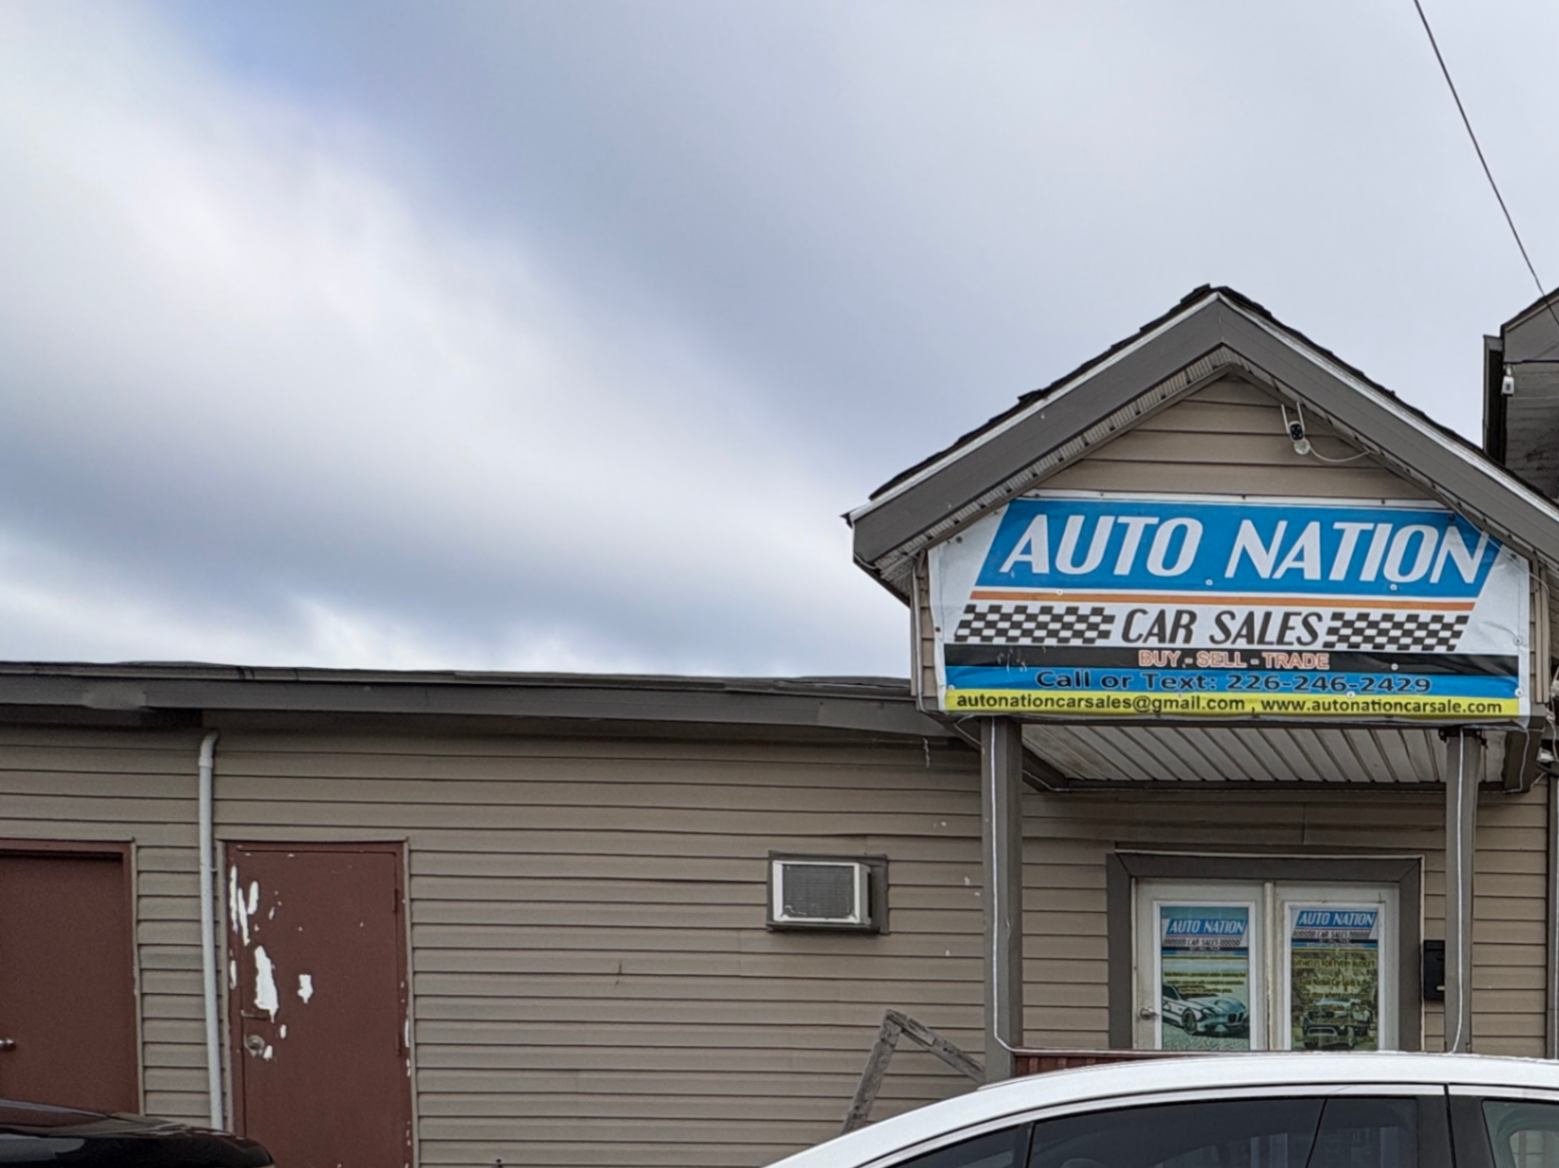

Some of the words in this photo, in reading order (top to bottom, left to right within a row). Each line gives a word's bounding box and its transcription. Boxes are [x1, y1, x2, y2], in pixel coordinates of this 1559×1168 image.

[999, 514, 1204, 577] AUTO
[1224, 519, 1490, 584] NATION
[1121, 608, 1198, 644] CAR
[1209, 610, 1323, 646] SALES
[1138, 650, 1181, 667] BUY
[1196, 651, 1247, 668] SELL
[1262, 652, 1330, 670] TRADE
[1035, 669, 1091, 689] Call
[1101, 674, 1131, 690] or
[1142, 672, 1217, 690] Text:
[1227, 674, 1431, 693] 226-246-2429
[956, 693, 1245, 713] autonationcarsales@gmail.com
[1261, 699, 1503, 714] www.autonationcarsale.com
[1169, 919, 1200, 933] AUTO
[1203, 919, 1245, 934] NATION
[1299, 912, 1330, 925] AUTO
[1332, 912, 1376, 926] NATION
